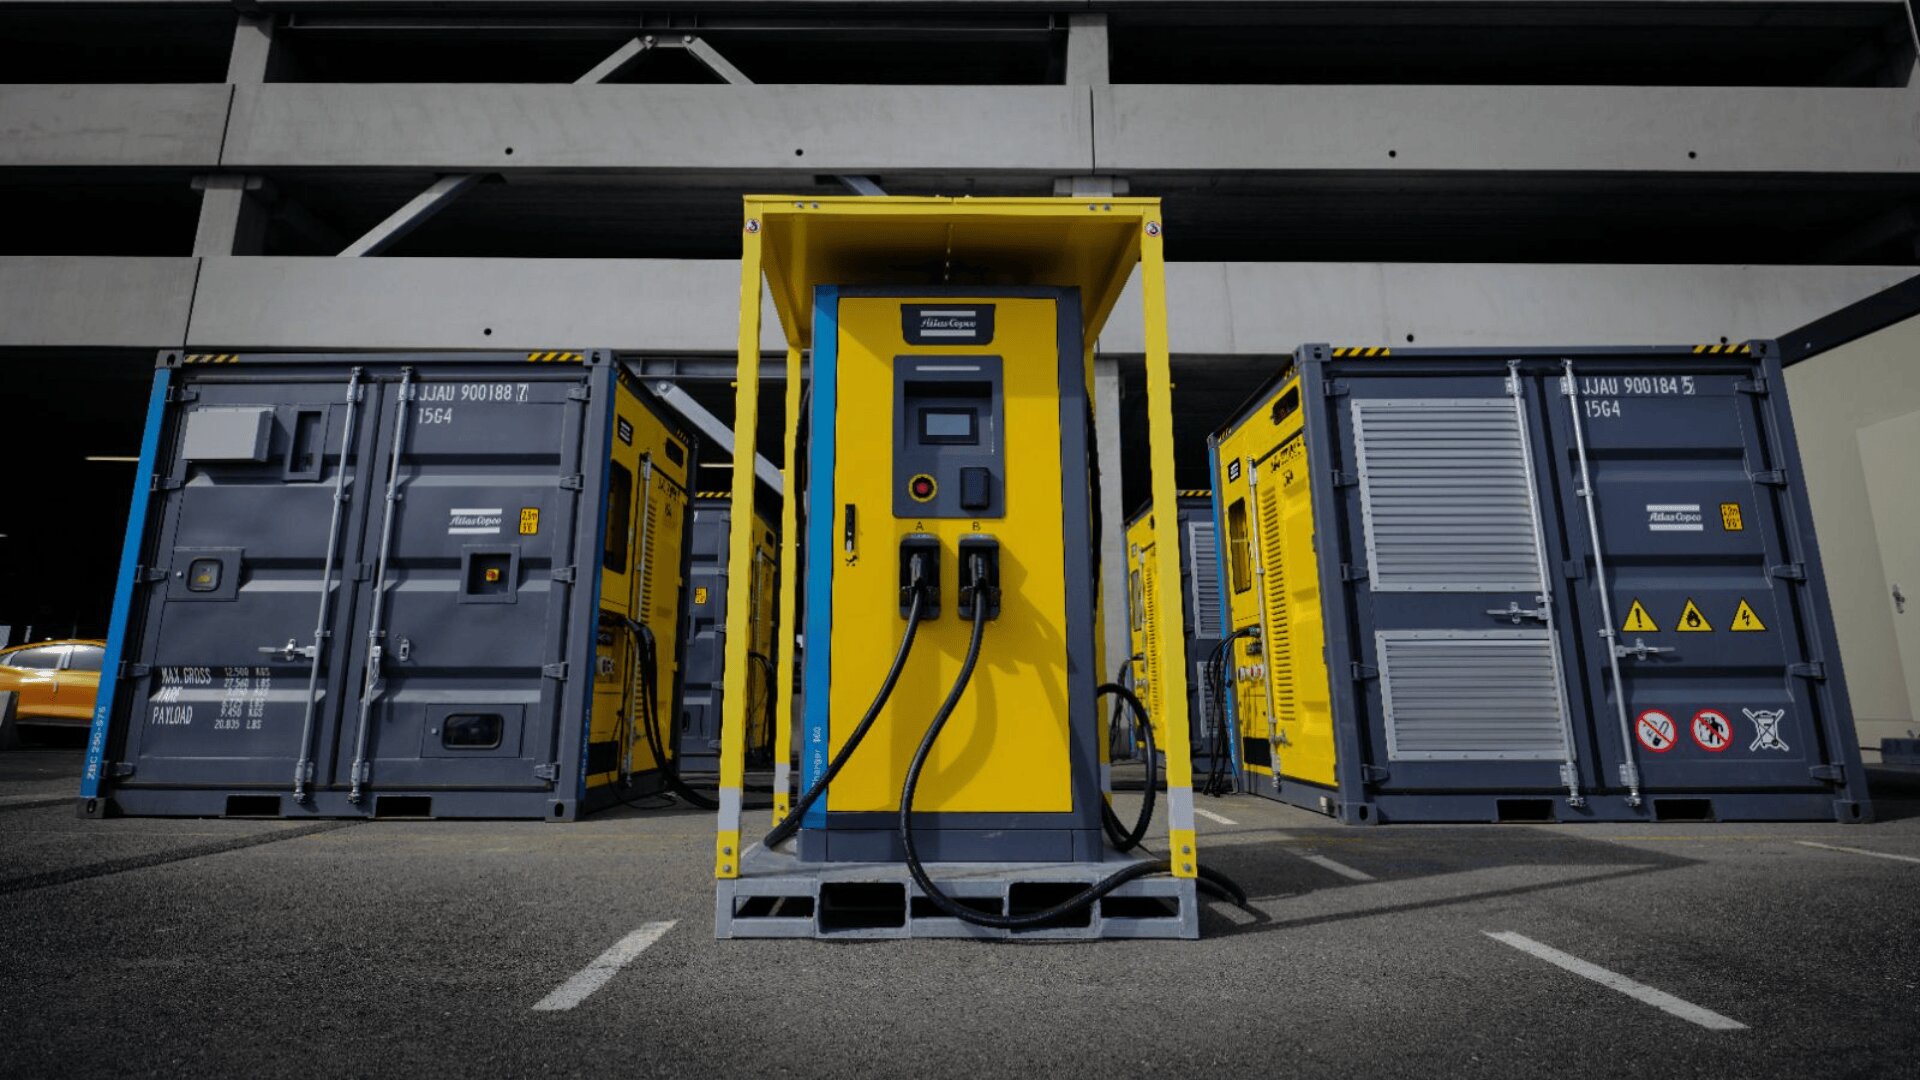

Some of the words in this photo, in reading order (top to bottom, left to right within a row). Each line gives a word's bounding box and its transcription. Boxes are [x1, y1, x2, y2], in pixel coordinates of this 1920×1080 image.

[920, 317, 948, 328] Atlas
[1582, 377, 1618, 395] JJAU
[1624, 376, 1678, 394] 900184
[418, 384, 455, 402] JJAU
[461, 384, 513, 401] 900188
[516, 383, 529, 402] 7
[1585, 400, 1621, 418] 15G4
[418, 408, 452, 424] 15G4
[449, 516, 475, 526] Atlas
[476, 516, 502, 527] Copco
[1648, 512, 1675, 522] Atlas
[1675, 512, 1702, 522] Copco
[915, 521, 924, 531] A
[972, 521, 981, 531] B
[152, 706, 193, 725] PAYLOAD
[246, 719, 262, 729] LBS
